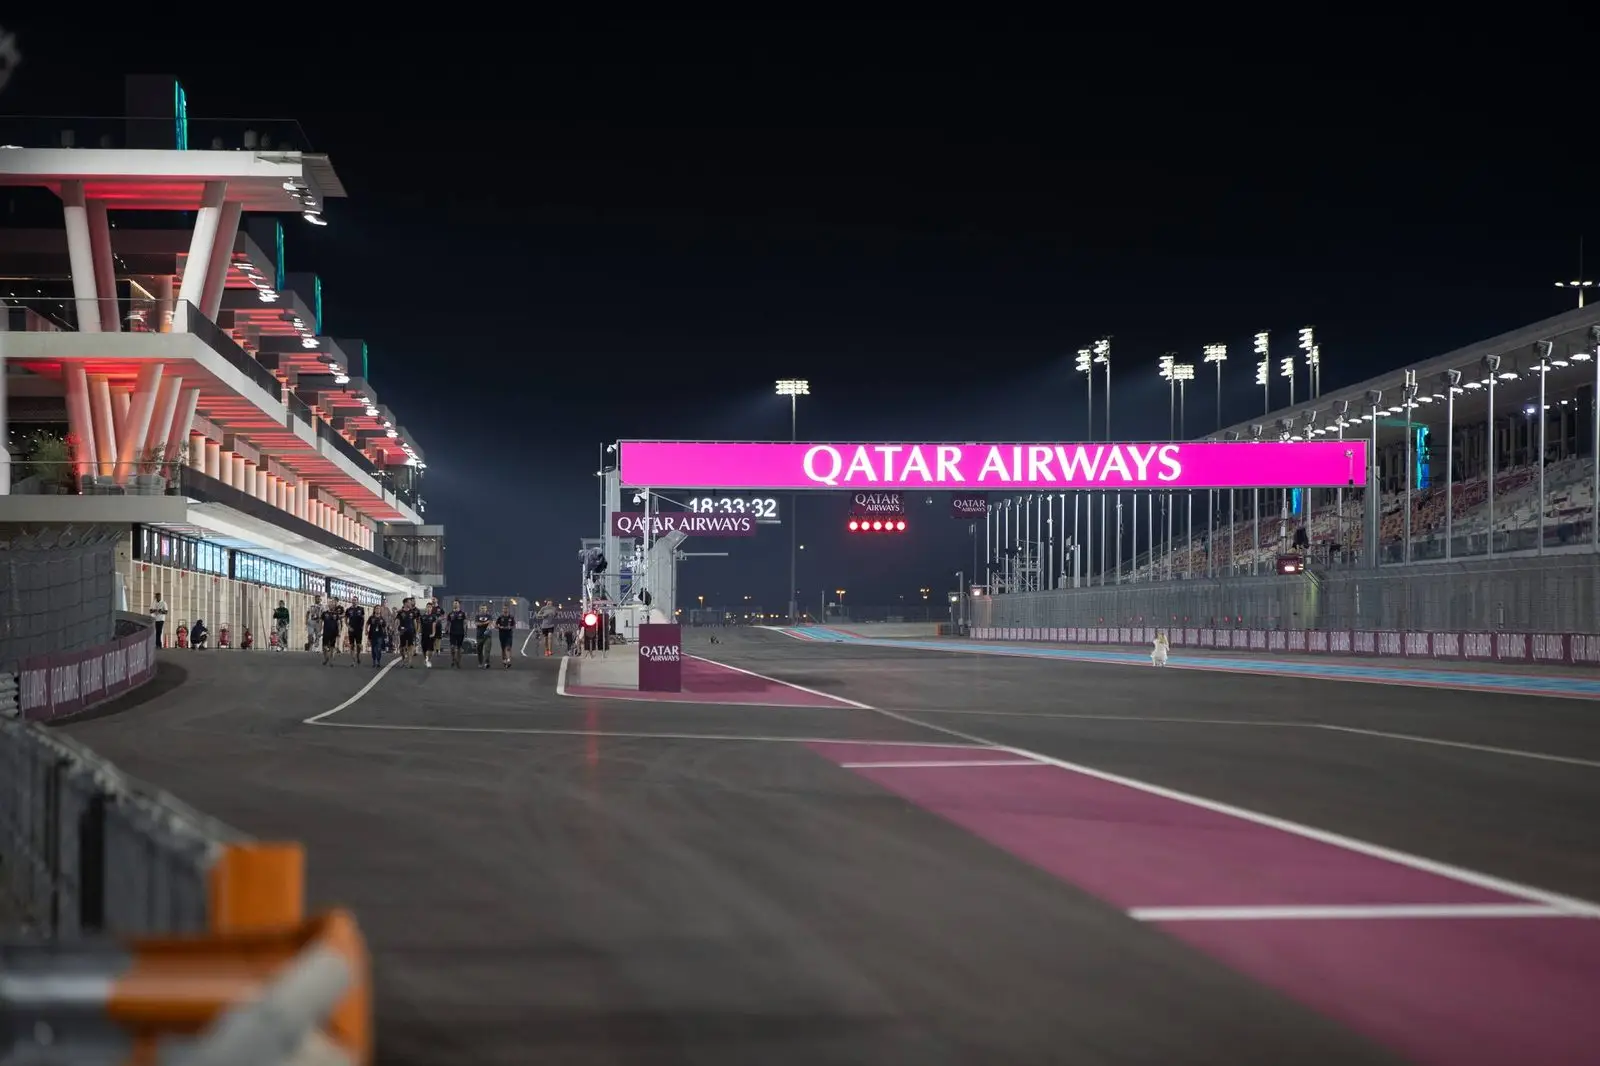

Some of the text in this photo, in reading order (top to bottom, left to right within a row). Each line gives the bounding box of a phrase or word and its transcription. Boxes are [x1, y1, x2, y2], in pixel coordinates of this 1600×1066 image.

[803, 445, 1182, 485] QATAR AIRWAYS
[856, 493, 899, 506] QATAR
[953, 500, 985, 508] QATAR
[689, 498, 777, 517] 18:33:32
[865, 504, 900, 512] AIRWAYS
[617, 517, 750, 533] QATAR AIRWAYS
[640, 646, 679, 657] QATAR
